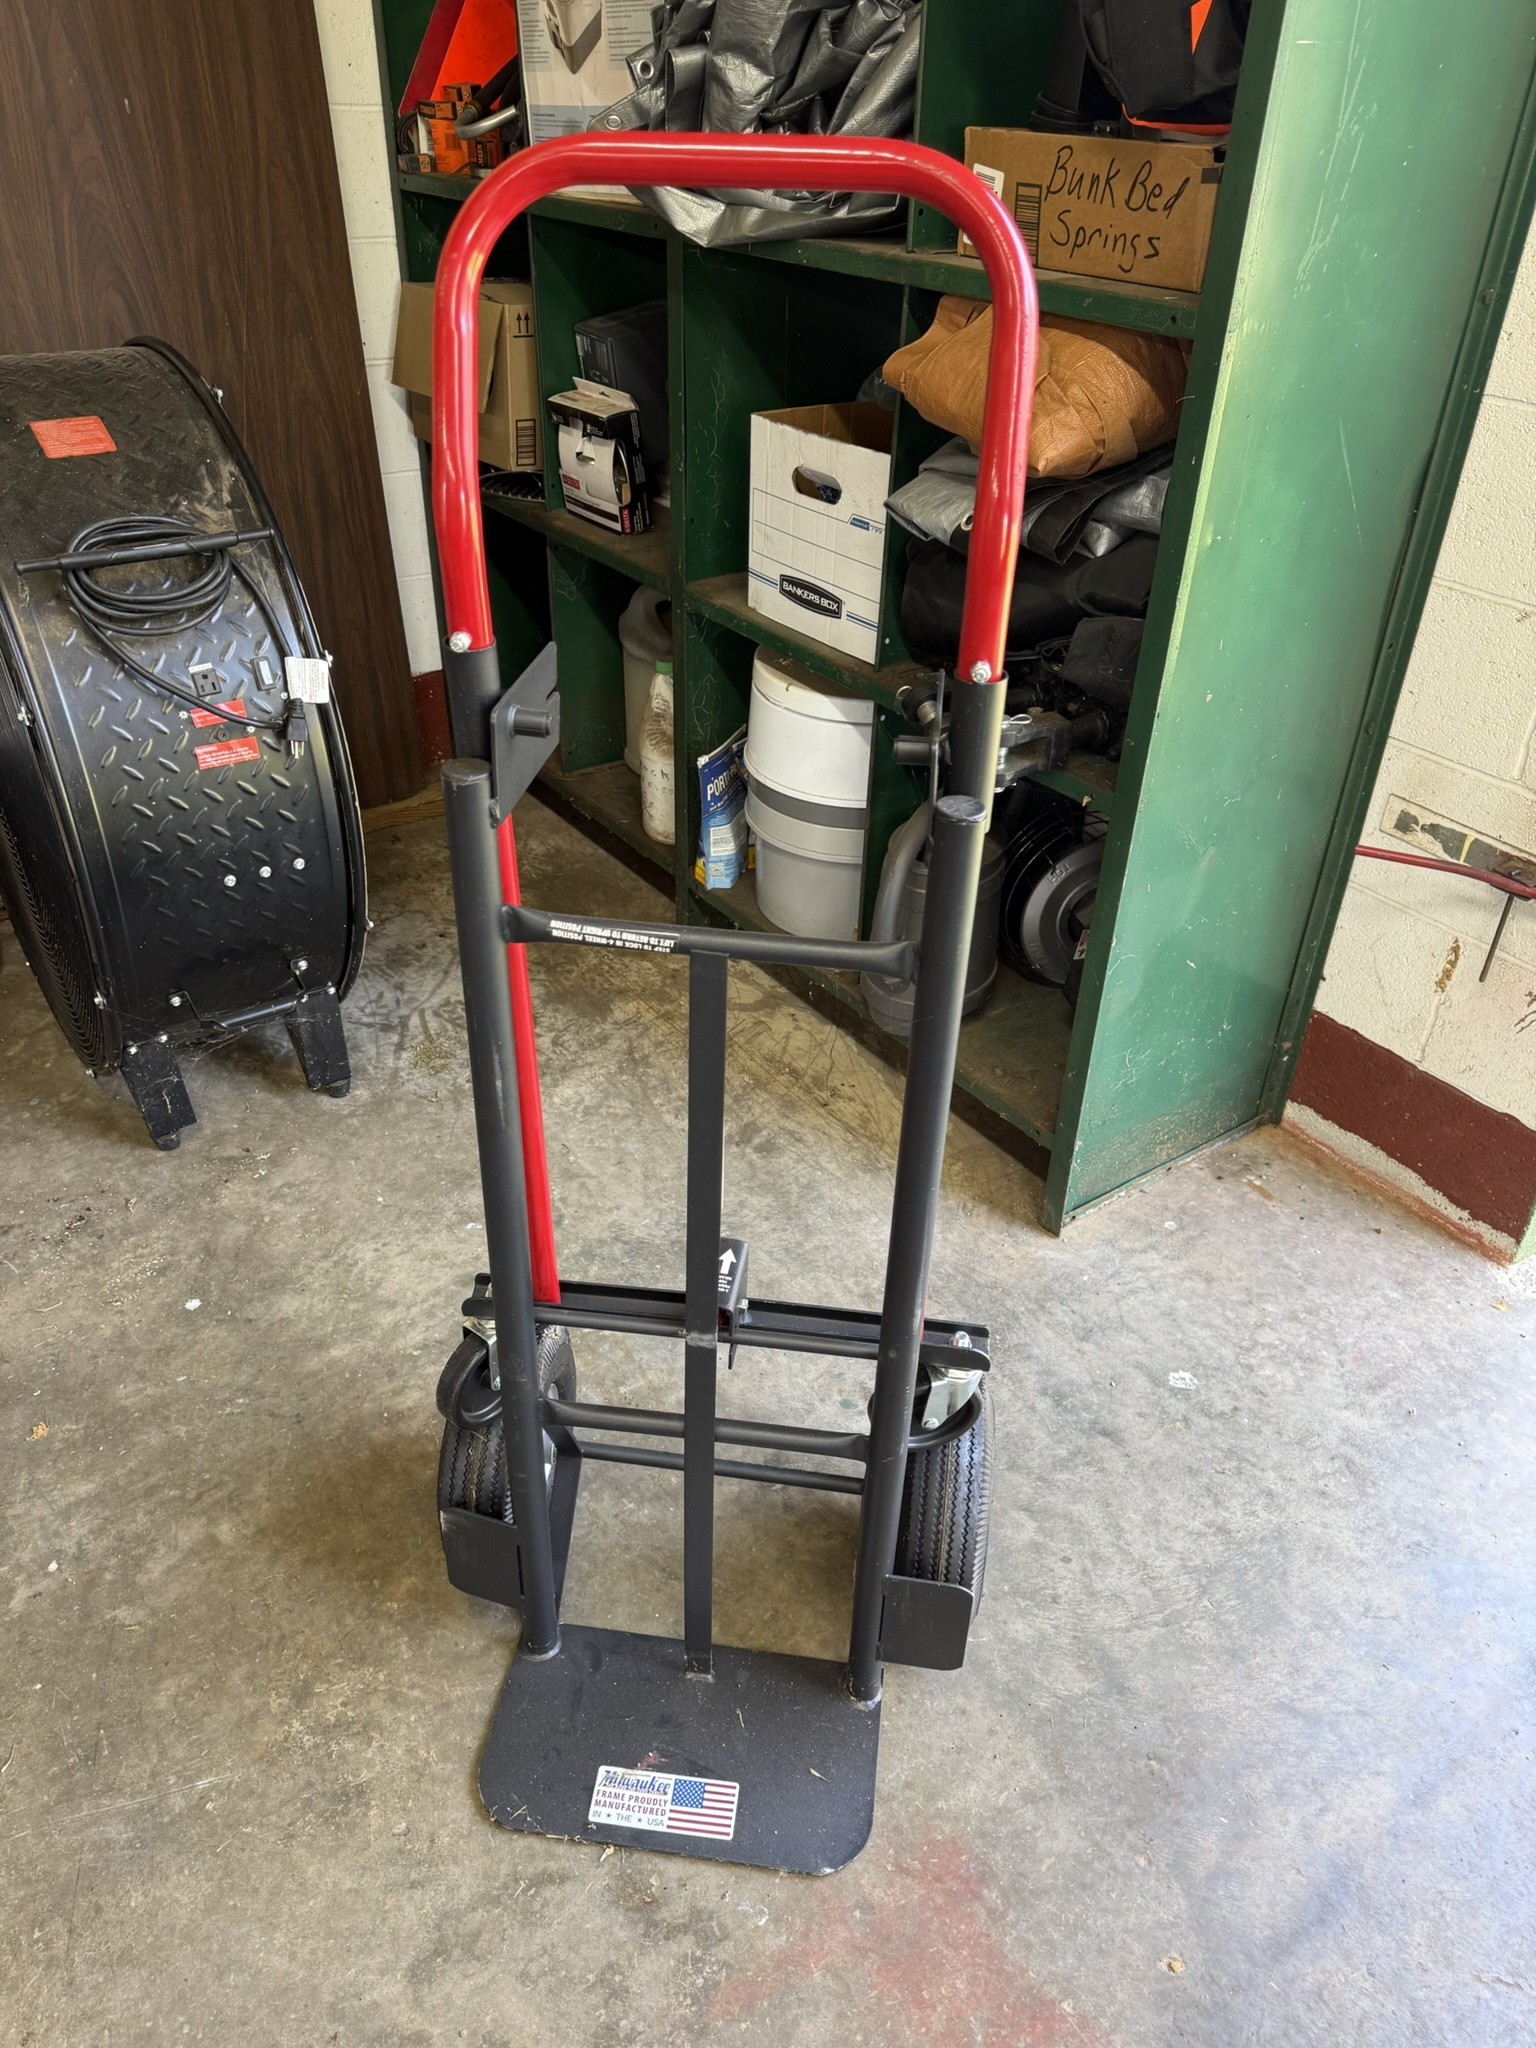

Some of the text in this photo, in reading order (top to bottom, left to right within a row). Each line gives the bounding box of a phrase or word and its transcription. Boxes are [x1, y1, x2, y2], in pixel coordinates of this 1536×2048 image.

[1044, 145, 1190, 219] Bunk Bed
[1050, 209, 1160, 273] Springs
[782, 581, 838, 612] BANKERS BOX
[550, 920, 674, 948] LIFT TO RETURN TO UPRIGHT POSITION
[552, 929, 583, 941] POSITION
[584, 935, 614, 946] 4-WHEEL
[625, 942, 642, 950] LOCK
[599, 1770, 671, 1793] Milwaukee
[596, 1789, 626, 1801] FRAME
[628, 1793, 669, 1807] PROUDLY
[594, 1799, 667, 1817] MANUFACTURED
[592, 1810, 665, 1827] IN THE USA
